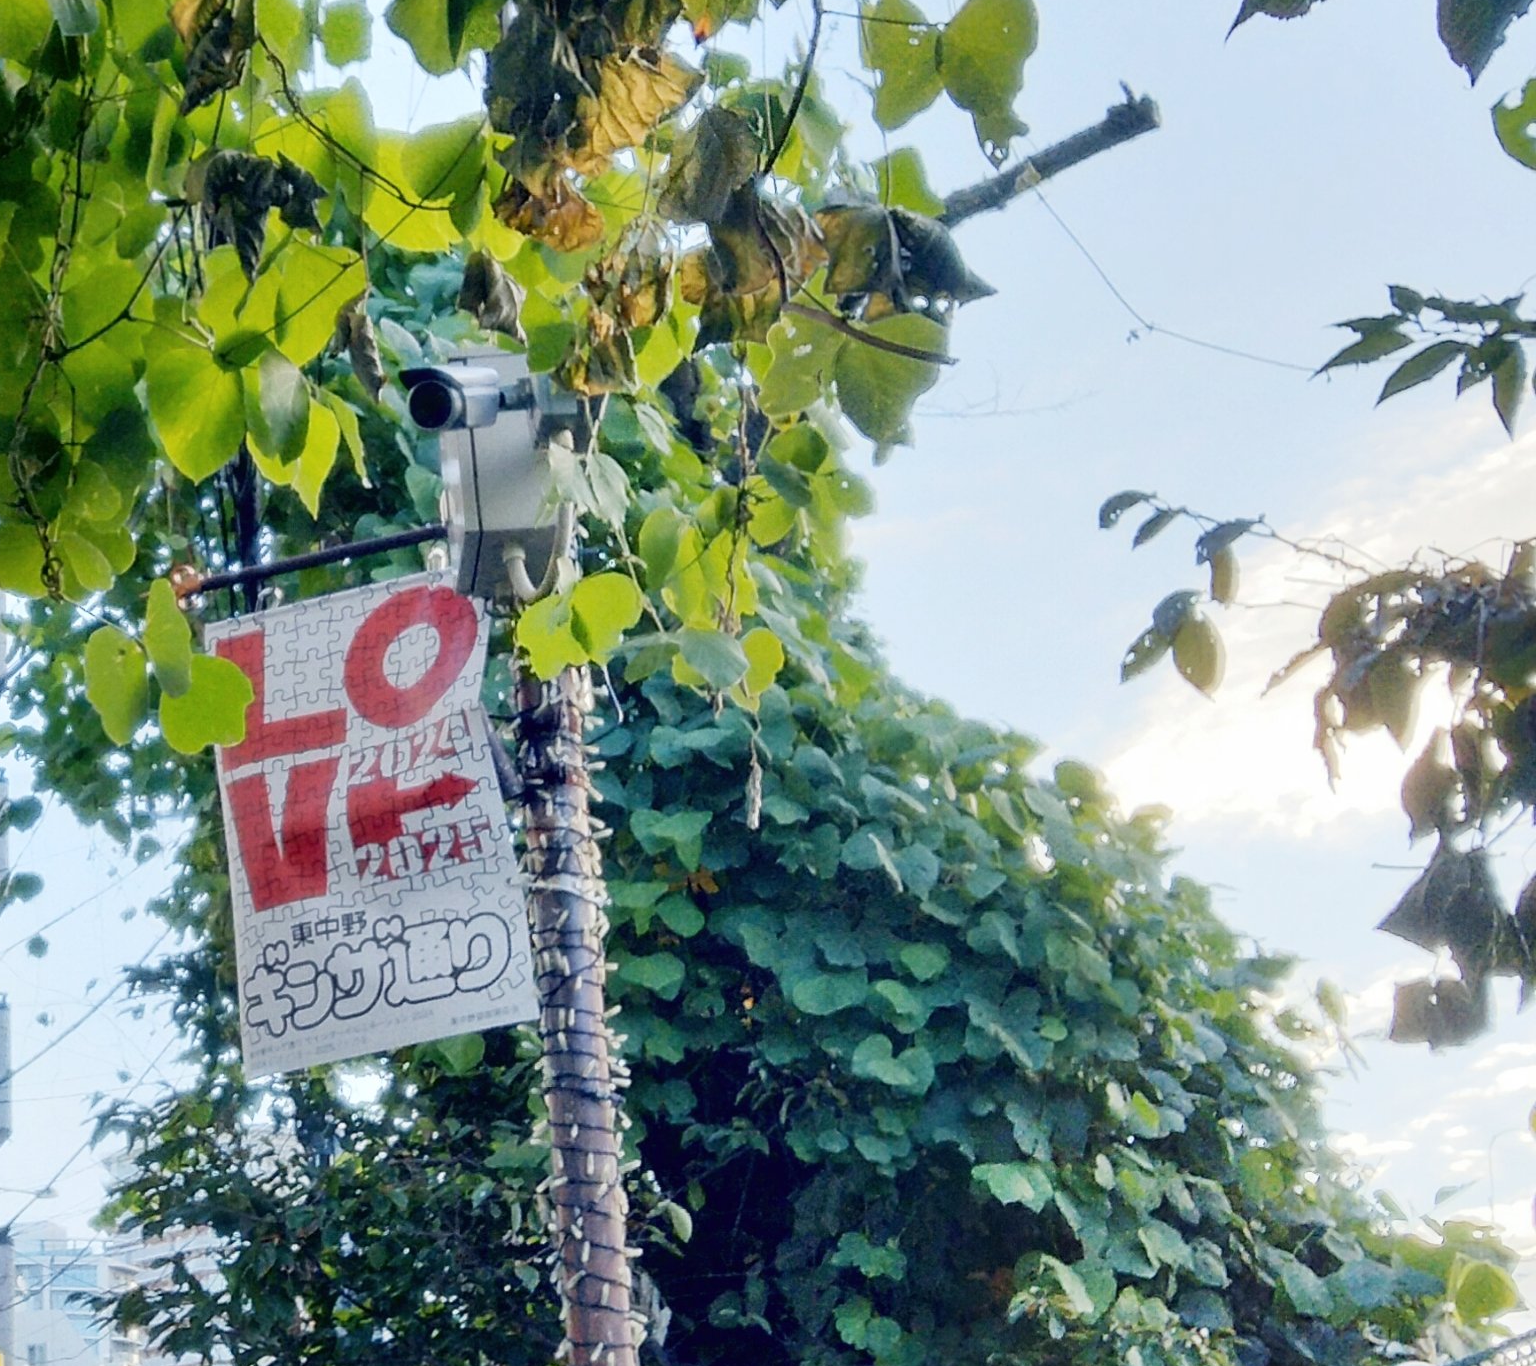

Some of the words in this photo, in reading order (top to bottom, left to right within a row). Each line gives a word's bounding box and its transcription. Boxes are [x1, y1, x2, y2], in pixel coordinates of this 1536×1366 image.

[353, 816, 491, 882] 2025
[291, 911, 368, 948] 東中野
[243, 909, 512, 1037] ギンザ通り
